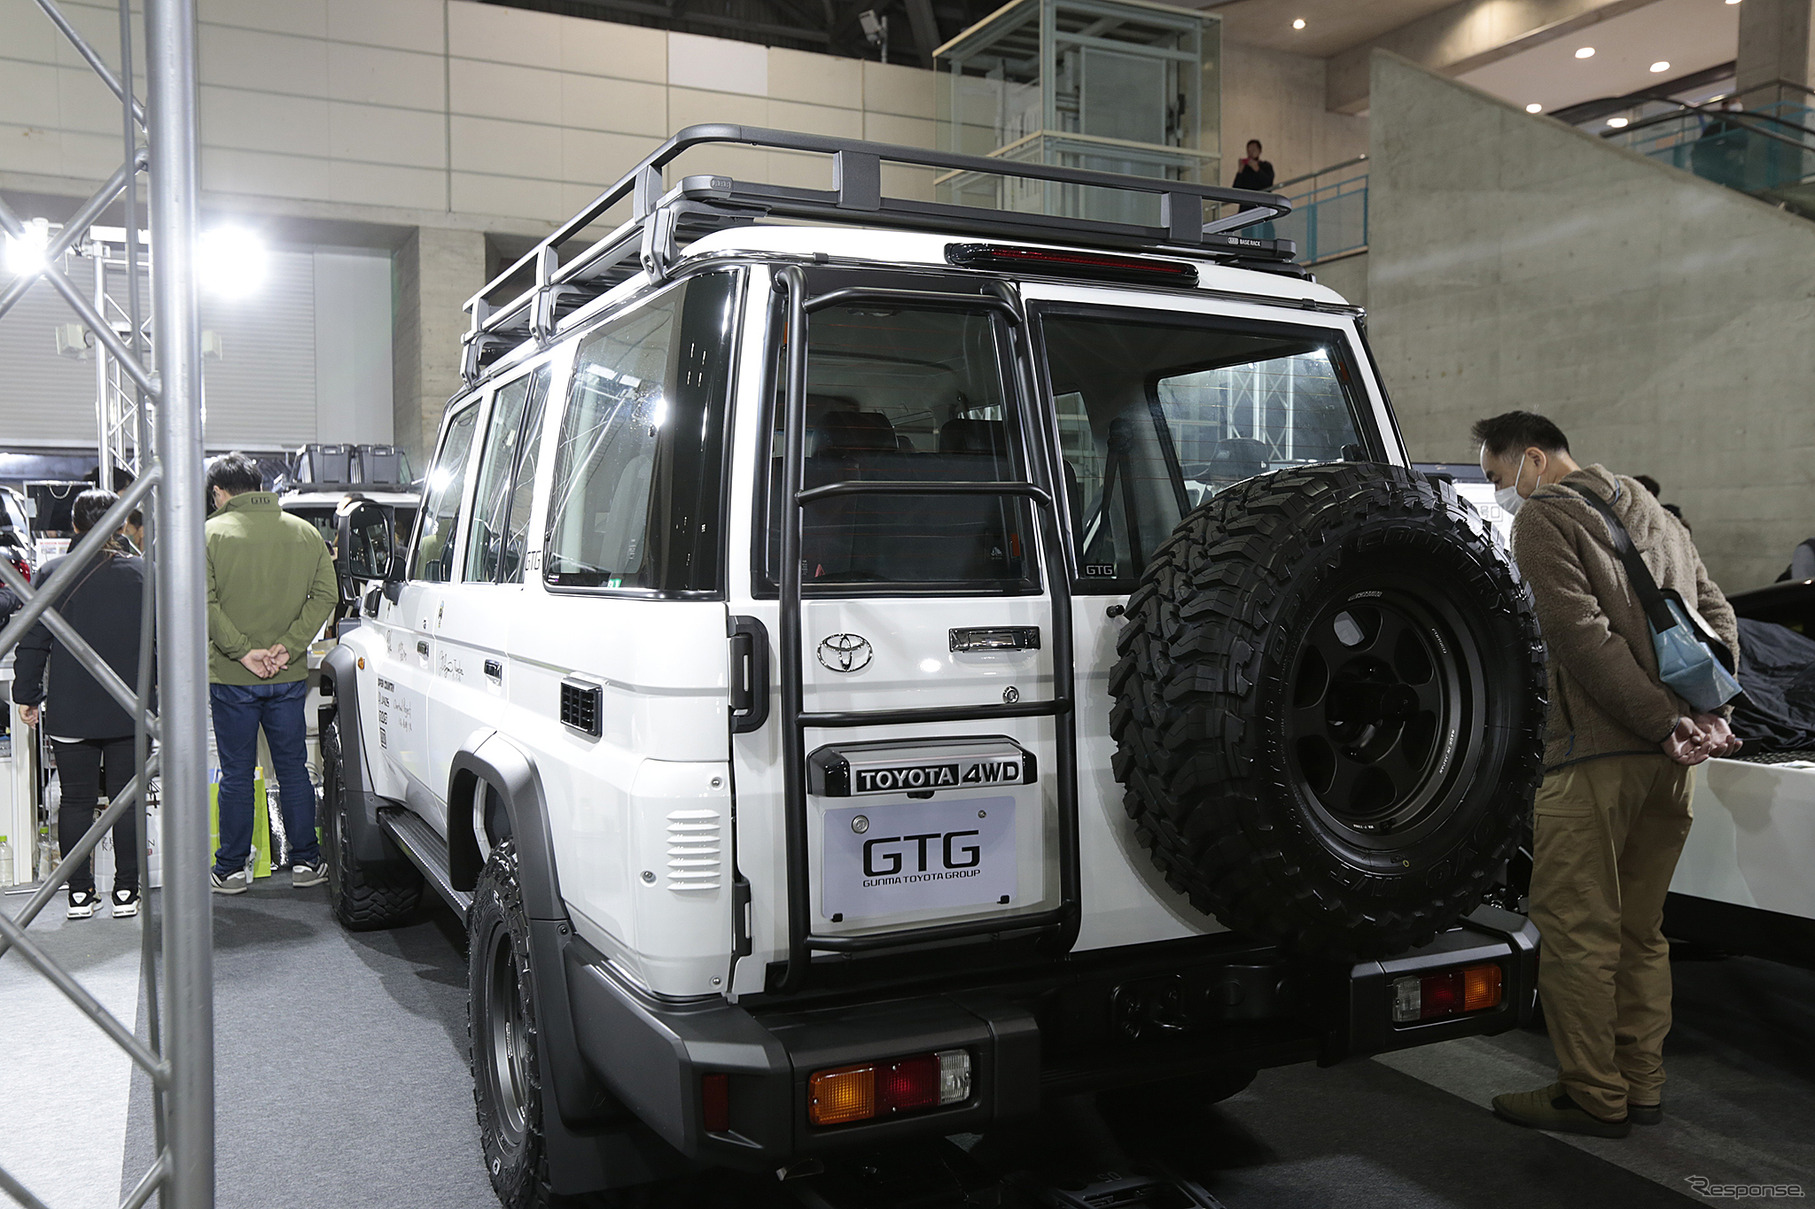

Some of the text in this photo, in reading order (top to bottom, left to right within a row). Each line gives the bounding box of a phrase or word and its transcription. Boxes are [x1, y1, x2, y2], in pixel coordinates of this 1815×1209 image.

[525, 550, 541, 571] GTG
[1086, 565, 1113, 575] GTG
[861, 761, 1020, 790] TOYOTA 4WD
[863, 830, 981, 877] GTG
[862, 869, 981, 888] GUNMA TOYOTA GROUP
